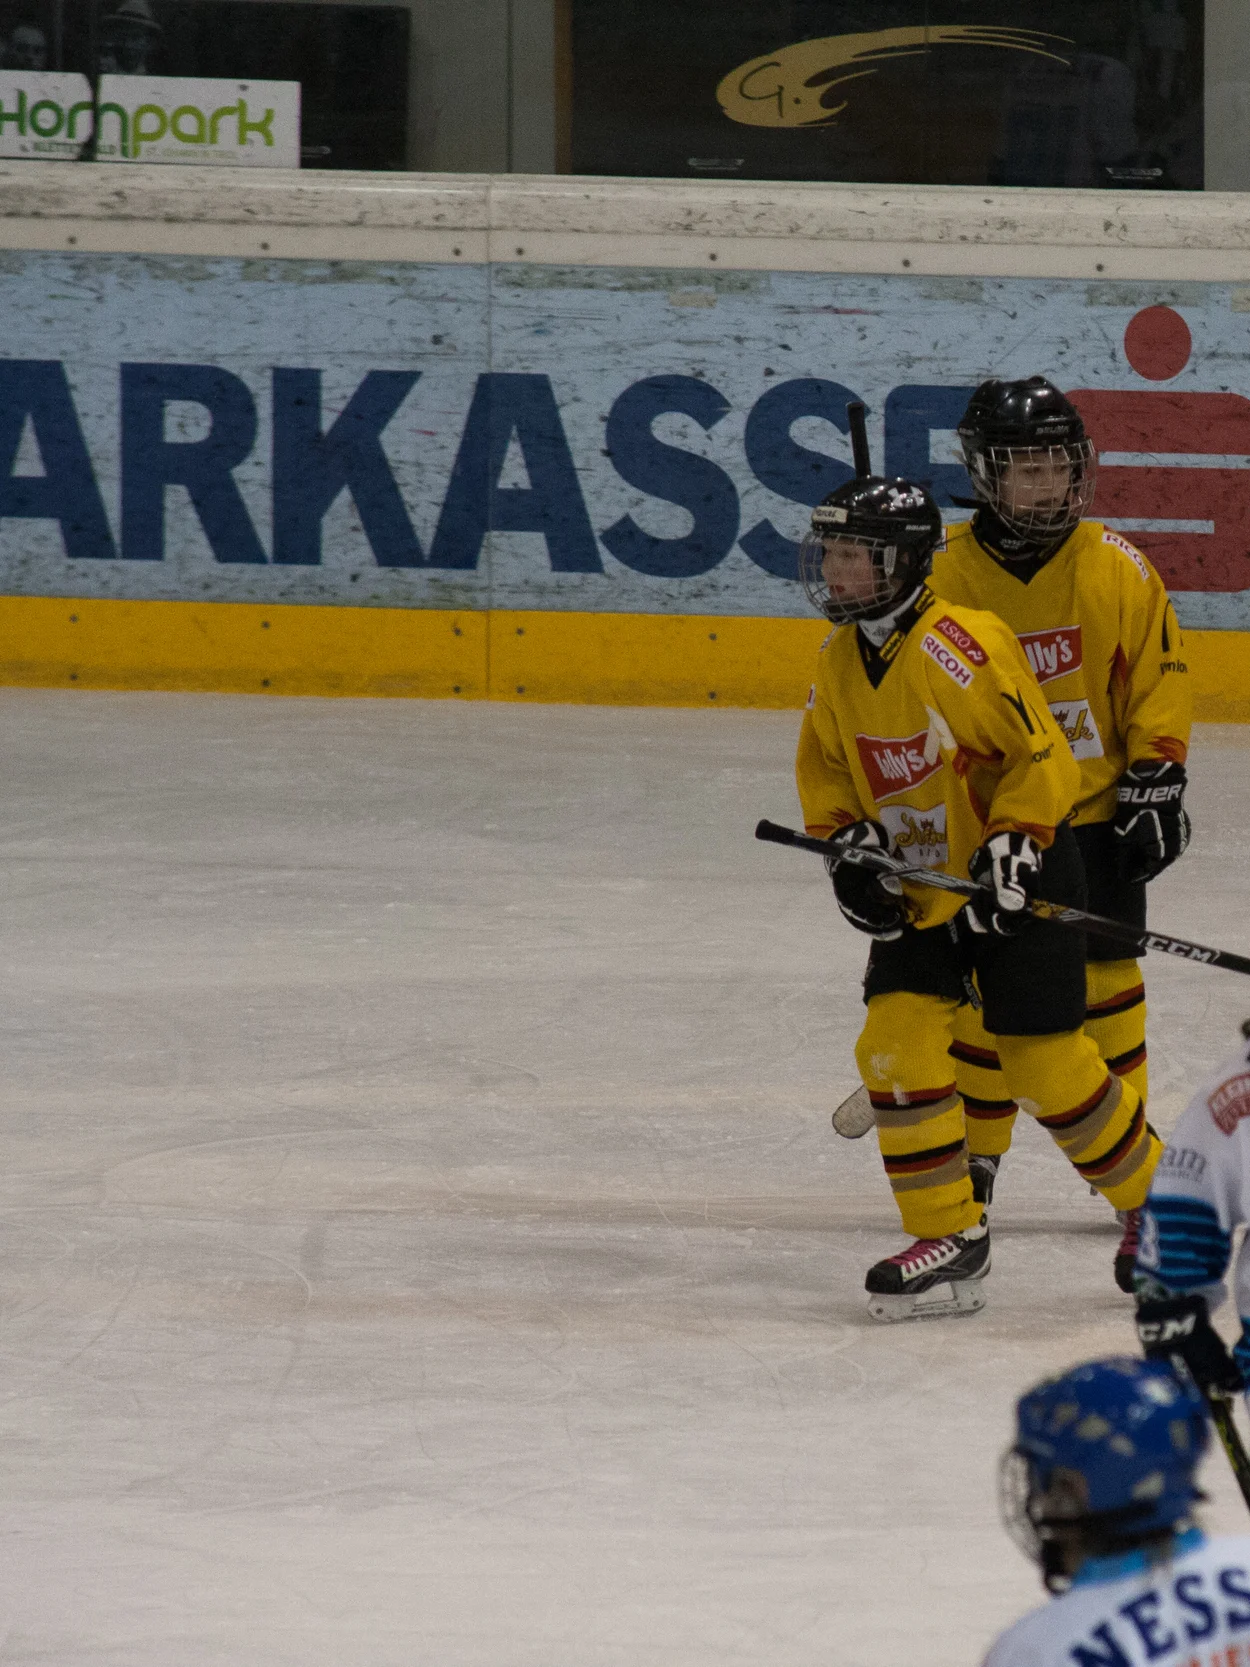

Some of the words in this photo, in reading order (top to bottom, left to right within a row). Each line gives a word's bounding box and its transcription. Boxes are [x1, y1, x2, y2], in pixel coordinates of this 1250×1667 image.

[938, 620, 970, 648] ASKO
[923, 636, 970, 684] RICOH
[1025, 635, 1073, 673] lly's
[1117, 783, 1182, 804] AUER
[1147, 936, 1213, 963] CCM
[1138, 1312, 1198, 1343] CM
